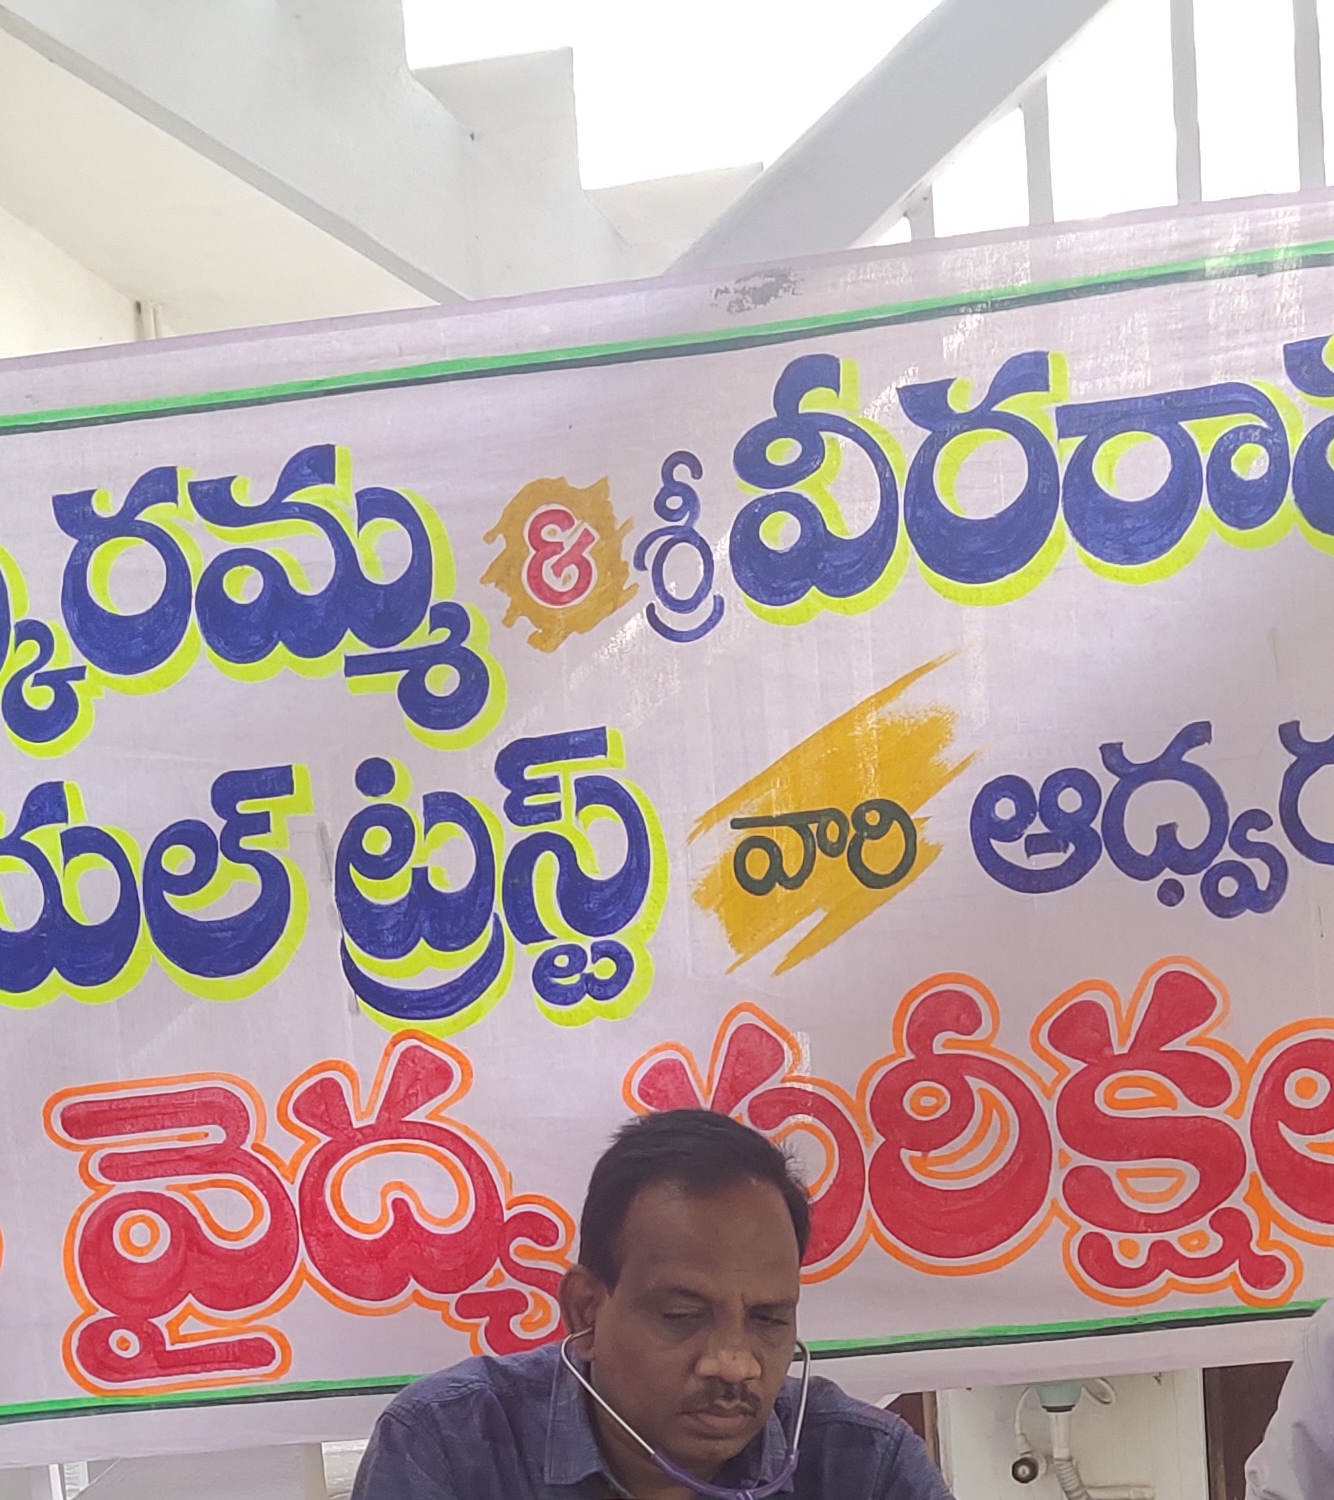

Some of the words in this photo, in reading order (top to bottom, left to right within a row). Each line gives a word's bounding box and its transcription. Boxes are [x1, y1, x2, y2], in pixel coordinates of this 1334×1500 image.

[524, 505, 598, 609] &
[633, 450, 726, 643] శ్రీ
[335, 727, 667, 1033] ట్రస్ట్
[731, 797, 917, 896] వారి
[44, 1028, 576, 1396] వైద్య
